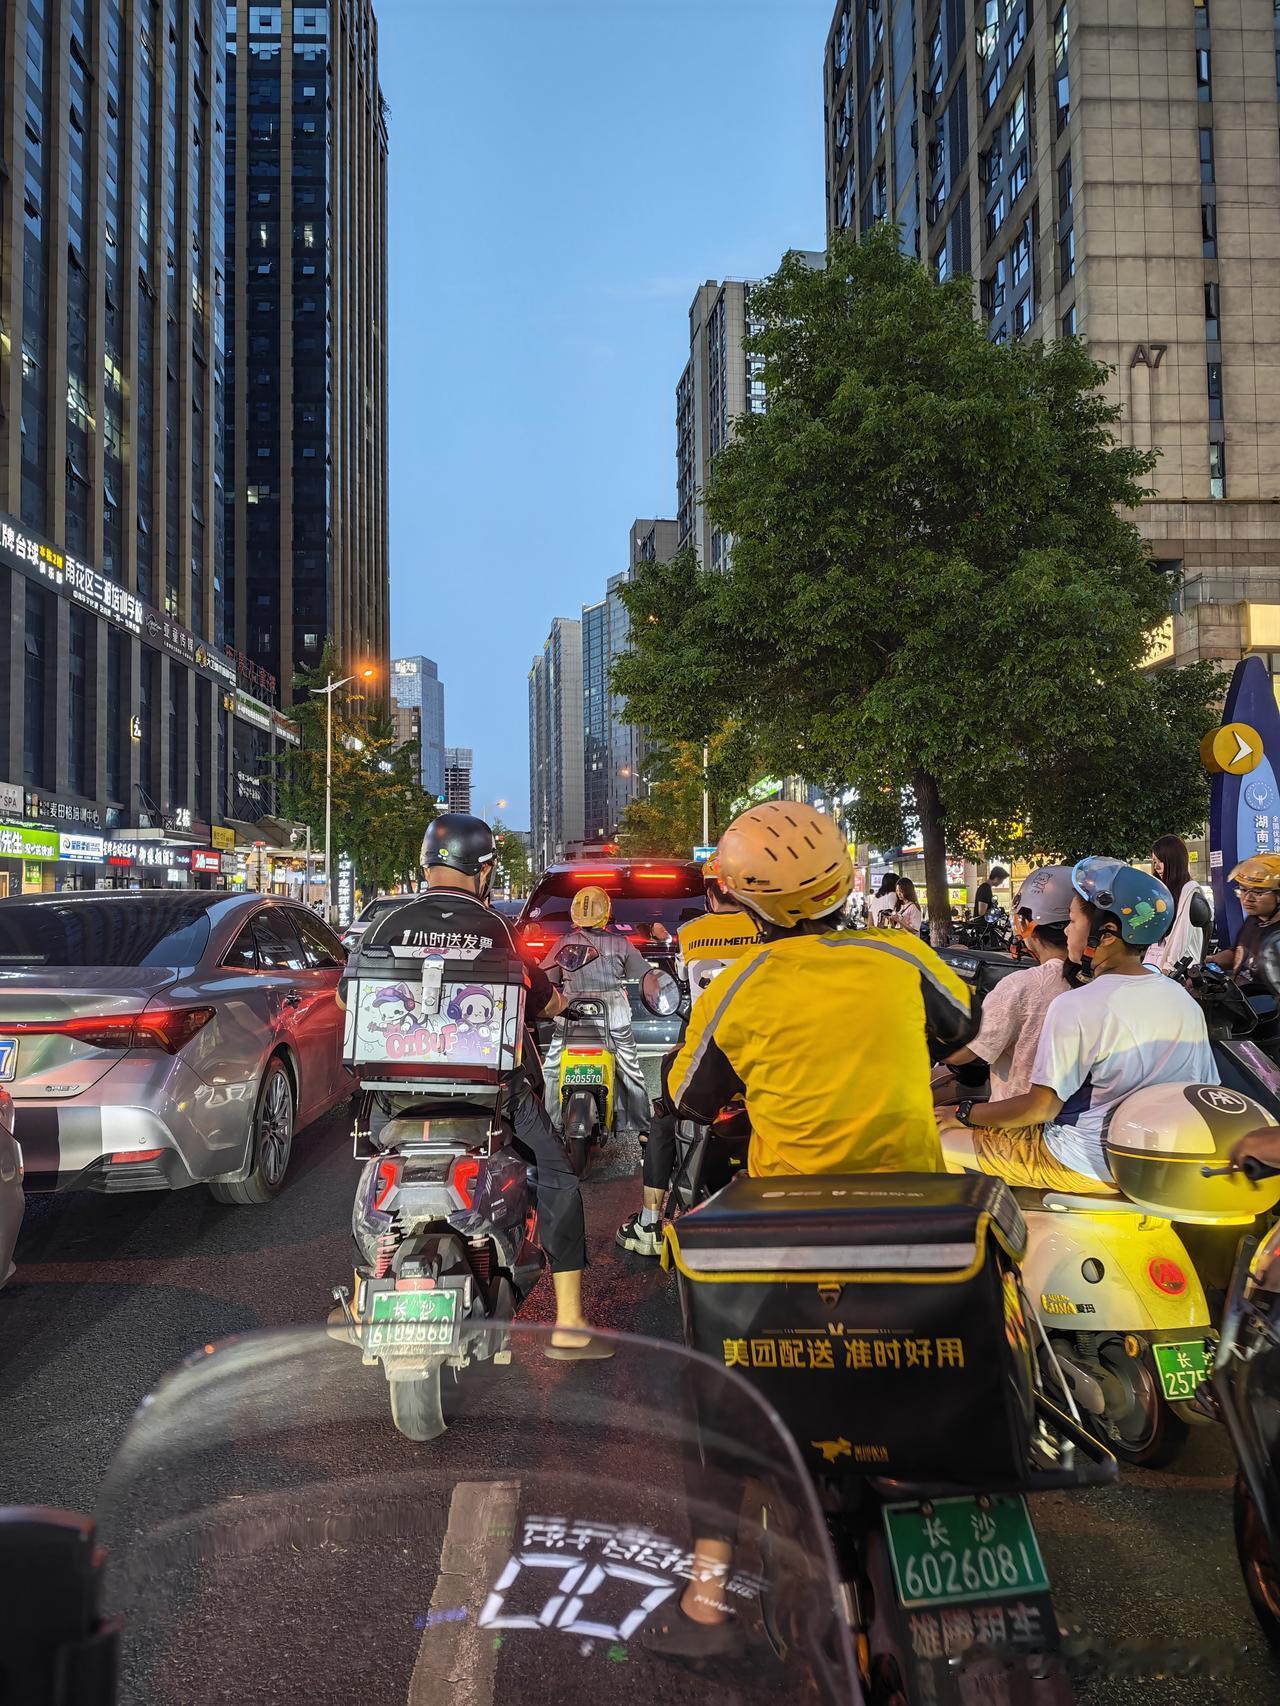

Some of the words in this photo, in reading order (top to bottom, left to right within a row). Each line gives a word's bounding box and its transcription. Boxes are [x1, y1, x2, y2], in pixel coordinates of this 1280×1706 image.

[1130, 344, 1168, 369] A7
[3, 796, 17, 808] SPA
[722, 1337, 835, 1369] 美团配送
[843, 1337, 965, 1369] 准时好用
[922, 1511, 997, 1549] 长沙
[905, 1540, 1034, 1598] 6026081
